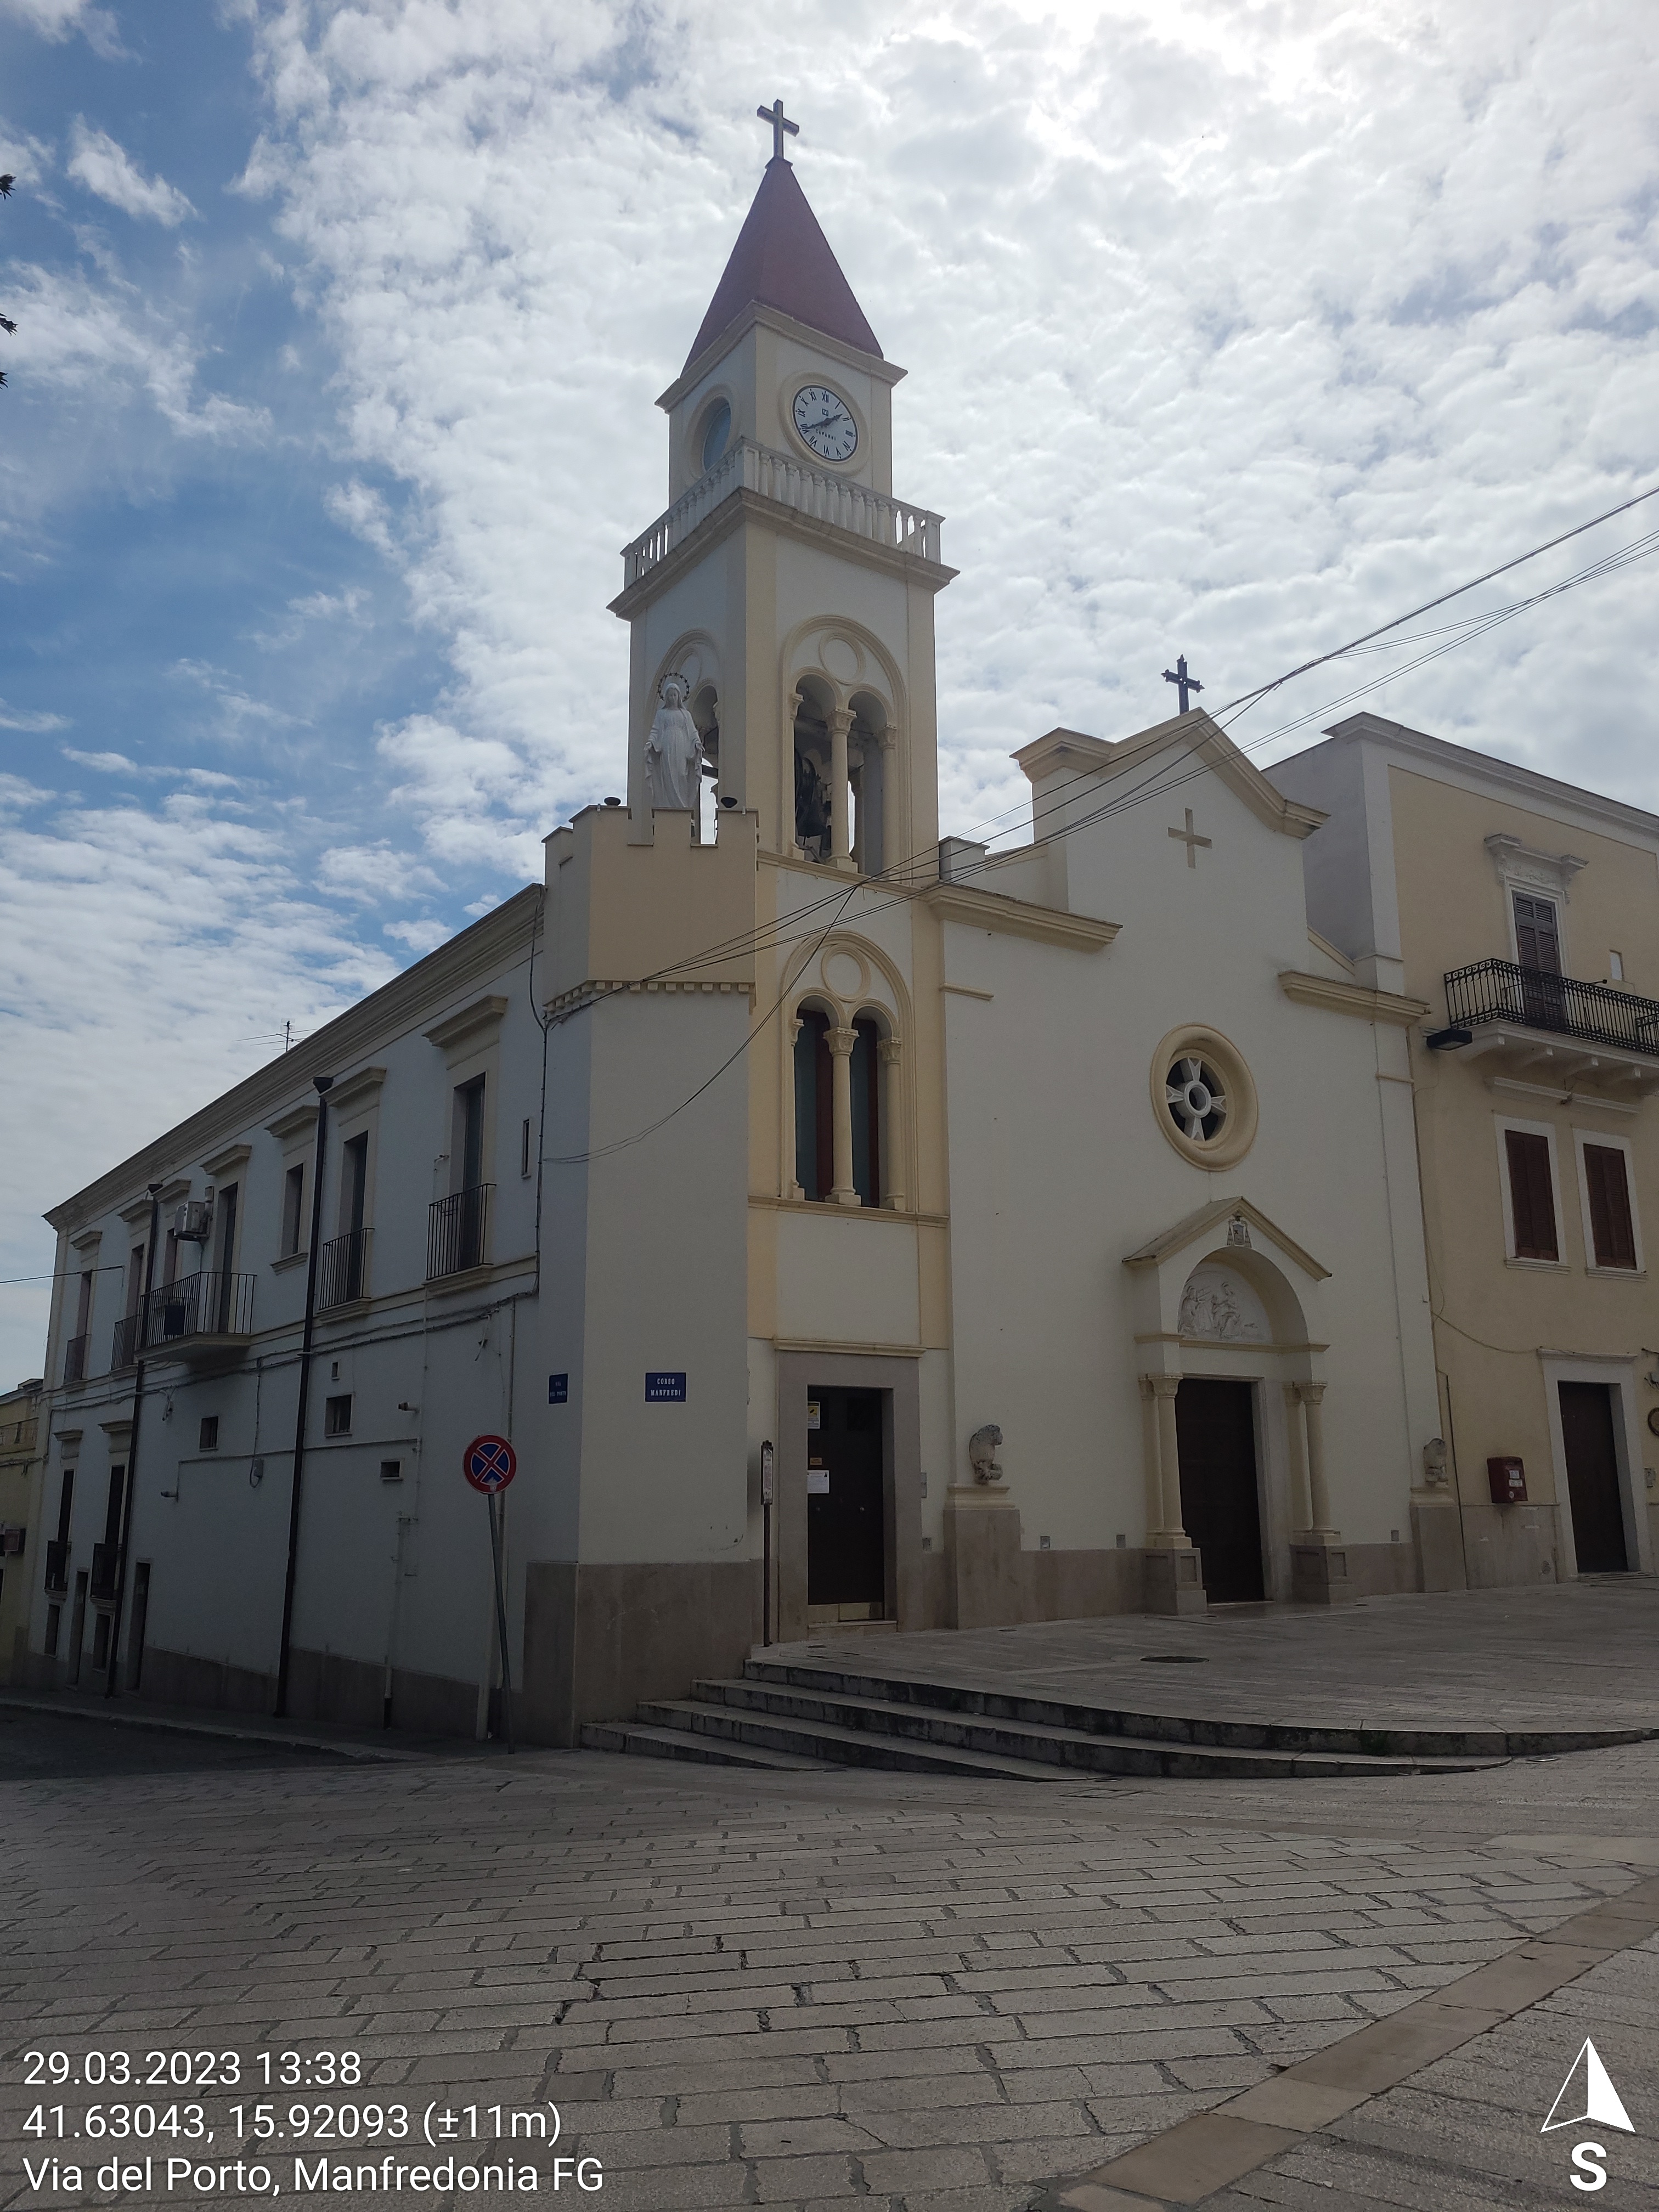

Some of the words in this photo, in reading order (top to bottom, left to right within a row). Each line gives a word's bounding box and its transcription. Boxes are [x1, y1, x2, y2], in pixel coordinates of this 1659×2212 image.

[800, 397, 809, 407] X
[797, 409, 805, 417] IX
[815, 429, 836, 441] CAPANNI
[823, 445, 830, 455] VI
[836, 447, 841, 456] V
